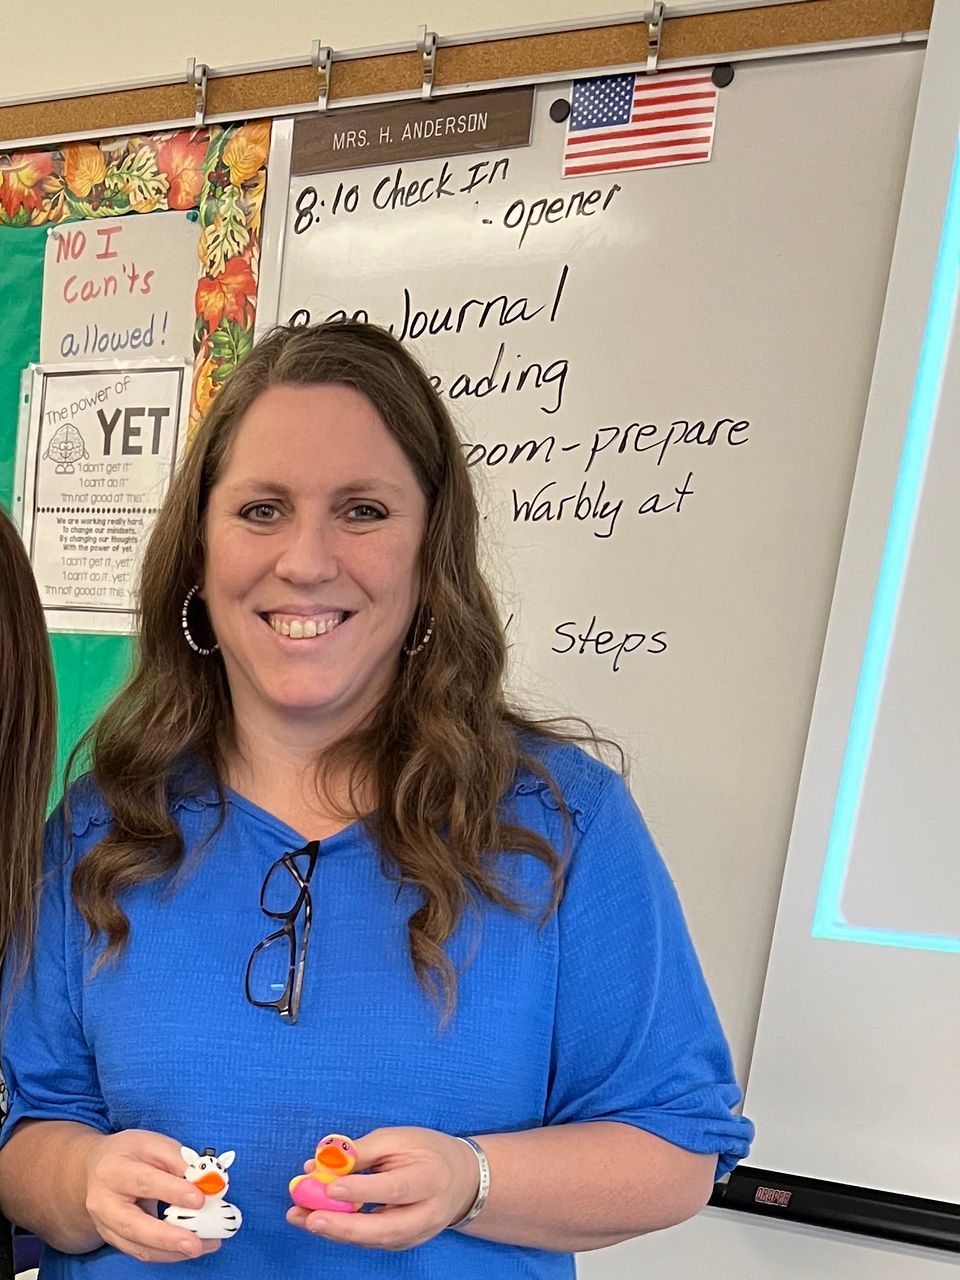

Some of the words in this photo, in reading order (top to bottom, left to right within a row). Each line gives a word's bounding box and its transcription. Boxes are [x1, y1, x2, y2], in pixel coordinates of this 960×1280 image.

[332, 131, 370, 150] MRS.
[378, 126, 393, 144] H.
[401, 112, 488, 142] ANDERSON
[294, 182, 360, 235] 8:10
[372, 161, 455, 211] Check
[459, 158, 510, 194] In
[56, 230, 86, 264] NO
[96, 226, 122, 260] I
[63, 262, 155, 304] Can'ts
[389, 264, 569, 343] Journal
[60, 310, 168, 358] allowed!
[45, 407, 69, 426] The
[70, 386, 112, 419] power
[114, 376, 132, 394] of
[427, 342, 569, 414] eading
[96, 407, 170, 456] YET
[56, 517, 66, 525] We
[67, 518, 79, 526] are
[80, 518, 106, 527] working
[107, 518, 126, 527] really
[512, 480, 624, 538] Warbly
[637, 472, 694, 514] at
[59, 534, 68, 544] By
[68, 536, 98, 544] changing
[110, 536, 138, 545] thoughts
[63, 544, 76, 552] With
[78, 544, 89, 552] the
[89, 545, 110, 553] power
[111, 544, 120, 552] of
[70, 527, 93, 536] change
[551, 615, 668, 672] Steps
